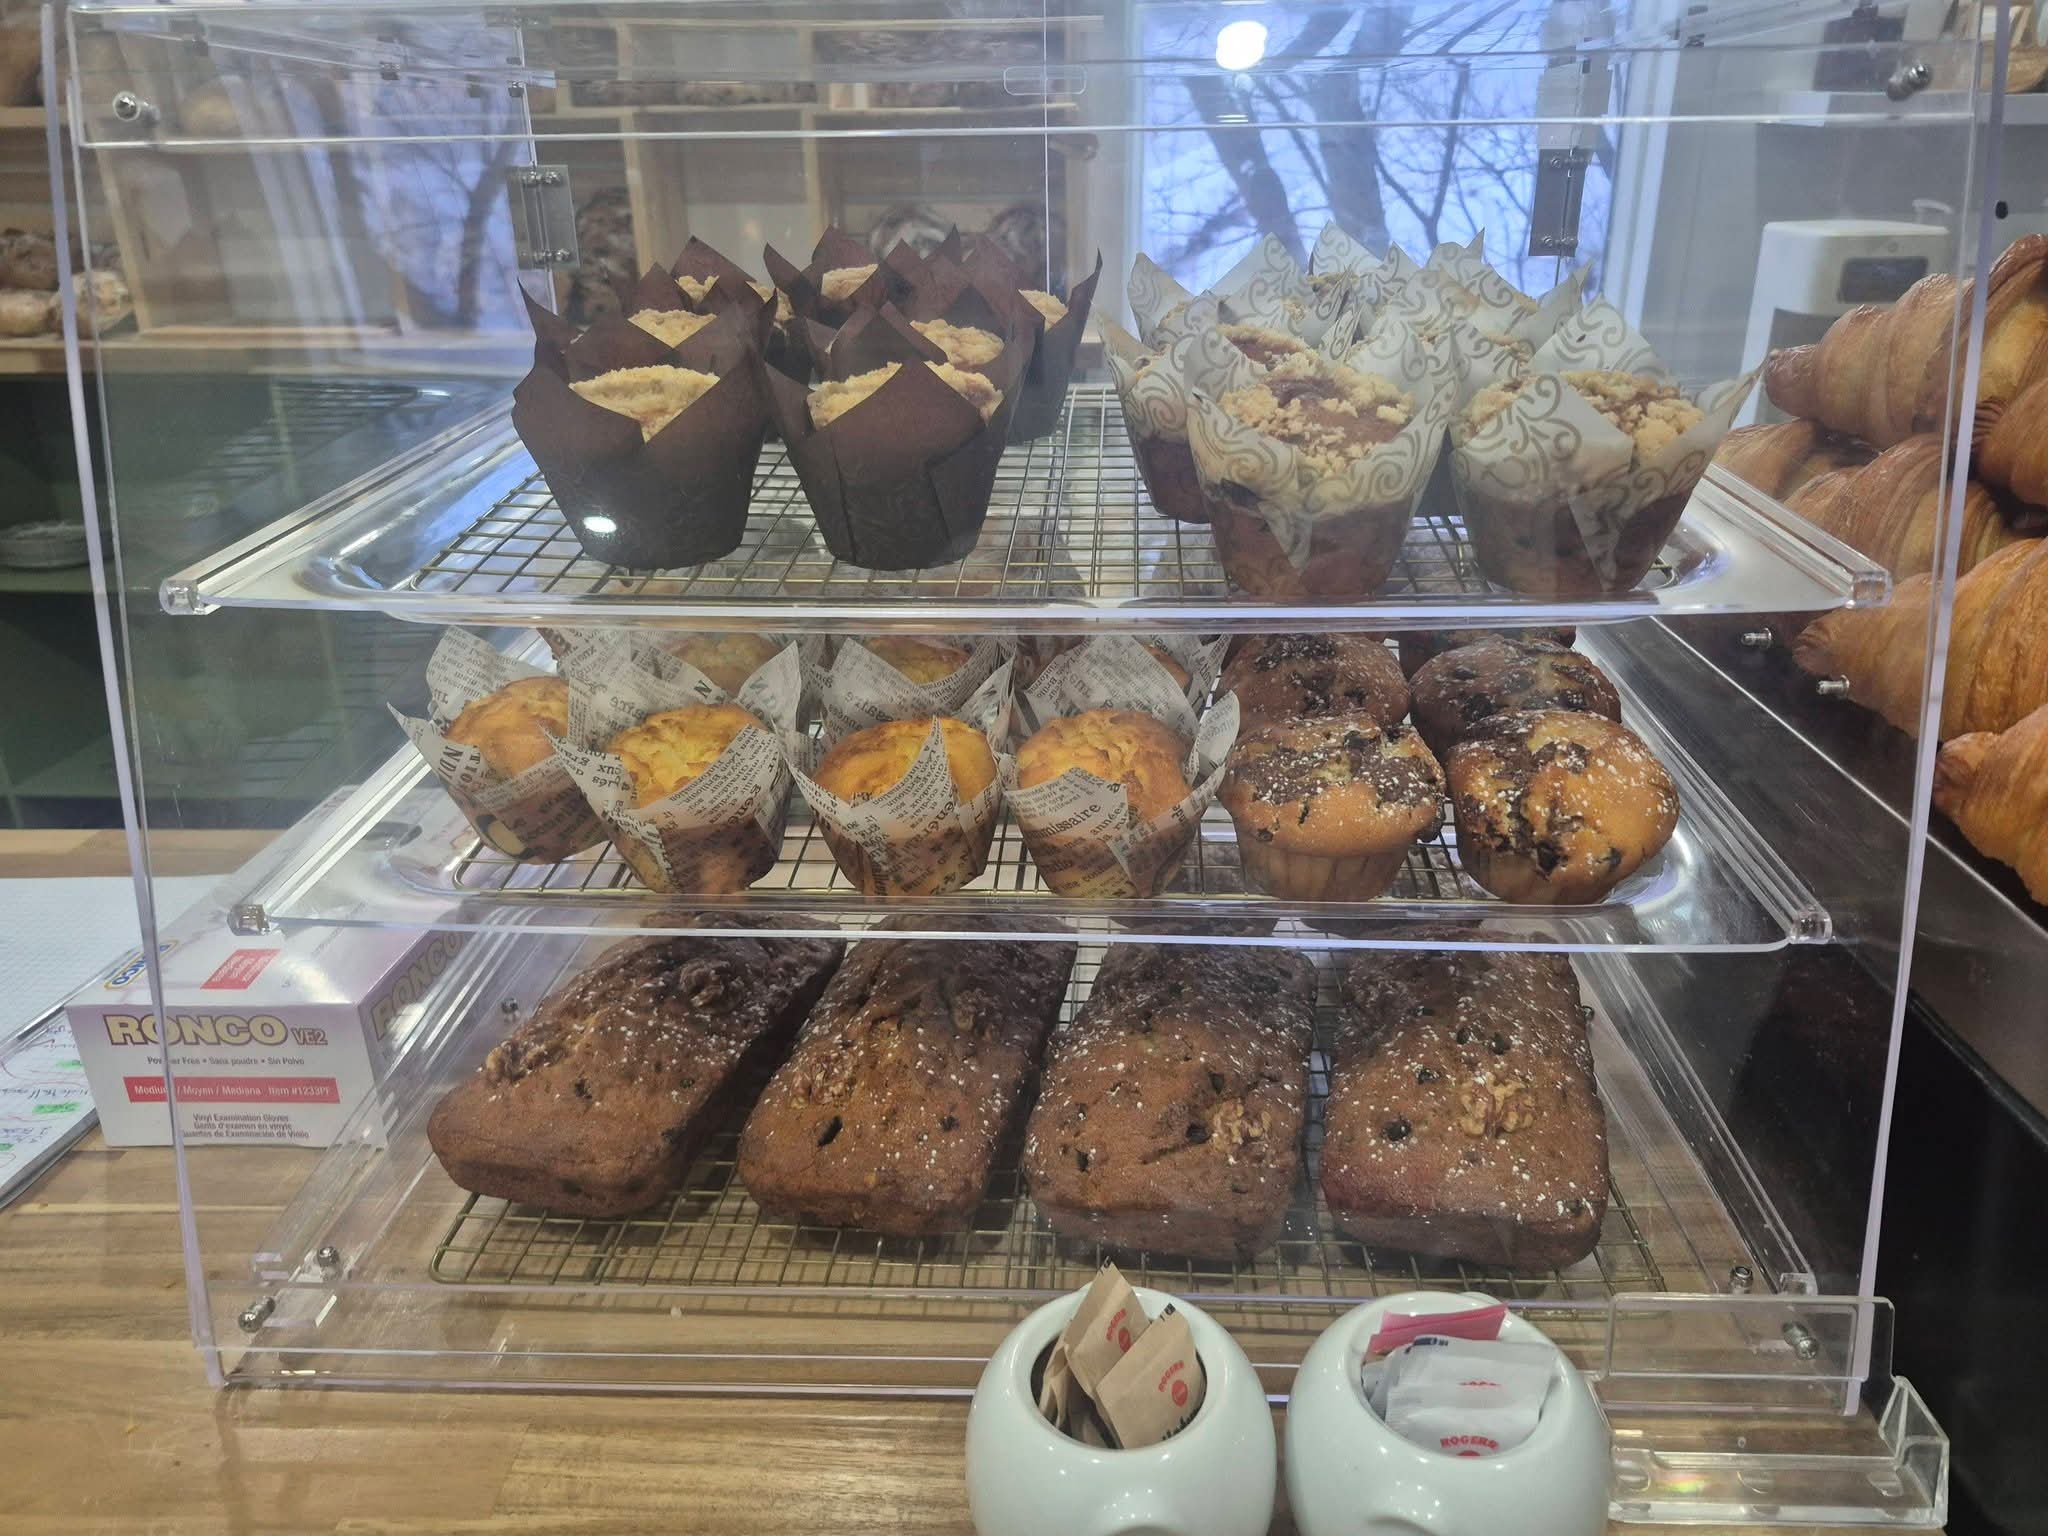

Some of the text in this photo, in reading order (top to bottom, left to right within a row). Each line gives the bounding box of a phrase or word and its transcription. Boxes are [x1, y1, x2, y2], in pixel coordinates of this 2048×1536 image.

[103, 1014, 288, 1046] RONCO
[291, 1028, 328, 1046] VE2
[267, 1056, 281, 1065] Sin
[134, 1085, 170, 1096] Mediu
[183, 1085, 214, 1097] Moyen
[268, 1086, 290, 1096] Item
[192, 1113, 289, 1123] Vinyl Examination Gloves
[1439, 1435, 1499, 1449] ROGERS
